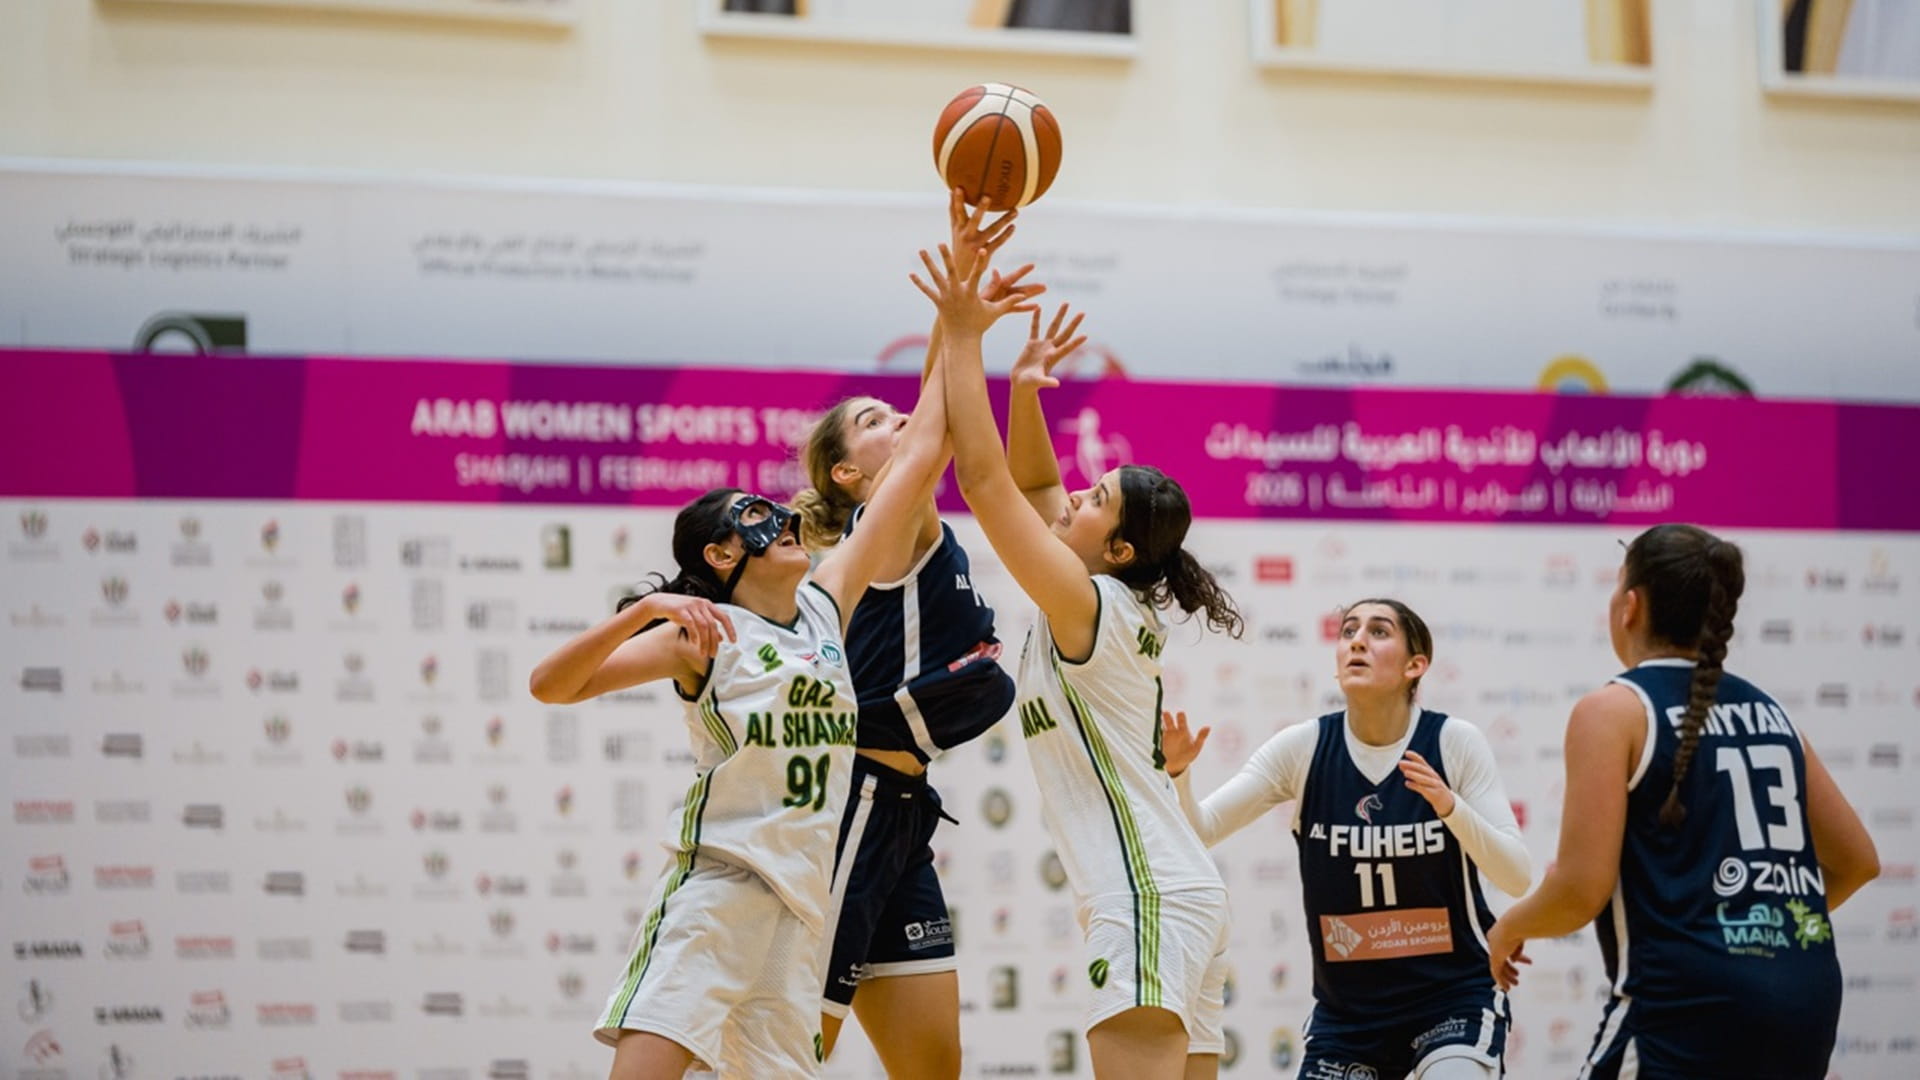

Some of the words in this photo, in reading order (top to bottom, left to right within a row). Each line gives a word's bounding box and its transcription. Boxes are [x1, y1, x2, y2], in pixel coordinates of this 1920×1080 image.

[411, 398, 498, 439] ARAB
[502, 400, 633, 443] WOMEN
[636, 403, 758, 446] SPORTS
[455, 452, 572, 493] SHARJAH
[599, 455, 730, 491] FEBRUARY
[744, 711, 776, 748] AL
[1716, 744, 1806, 852] 13
[1309, 822, 1328, 840] AL
[1329, 819, 1445, 858] FUHEIS
[1353, 862, 1398, 908] 11
[1723, 926, 1791, 949] MAHA
